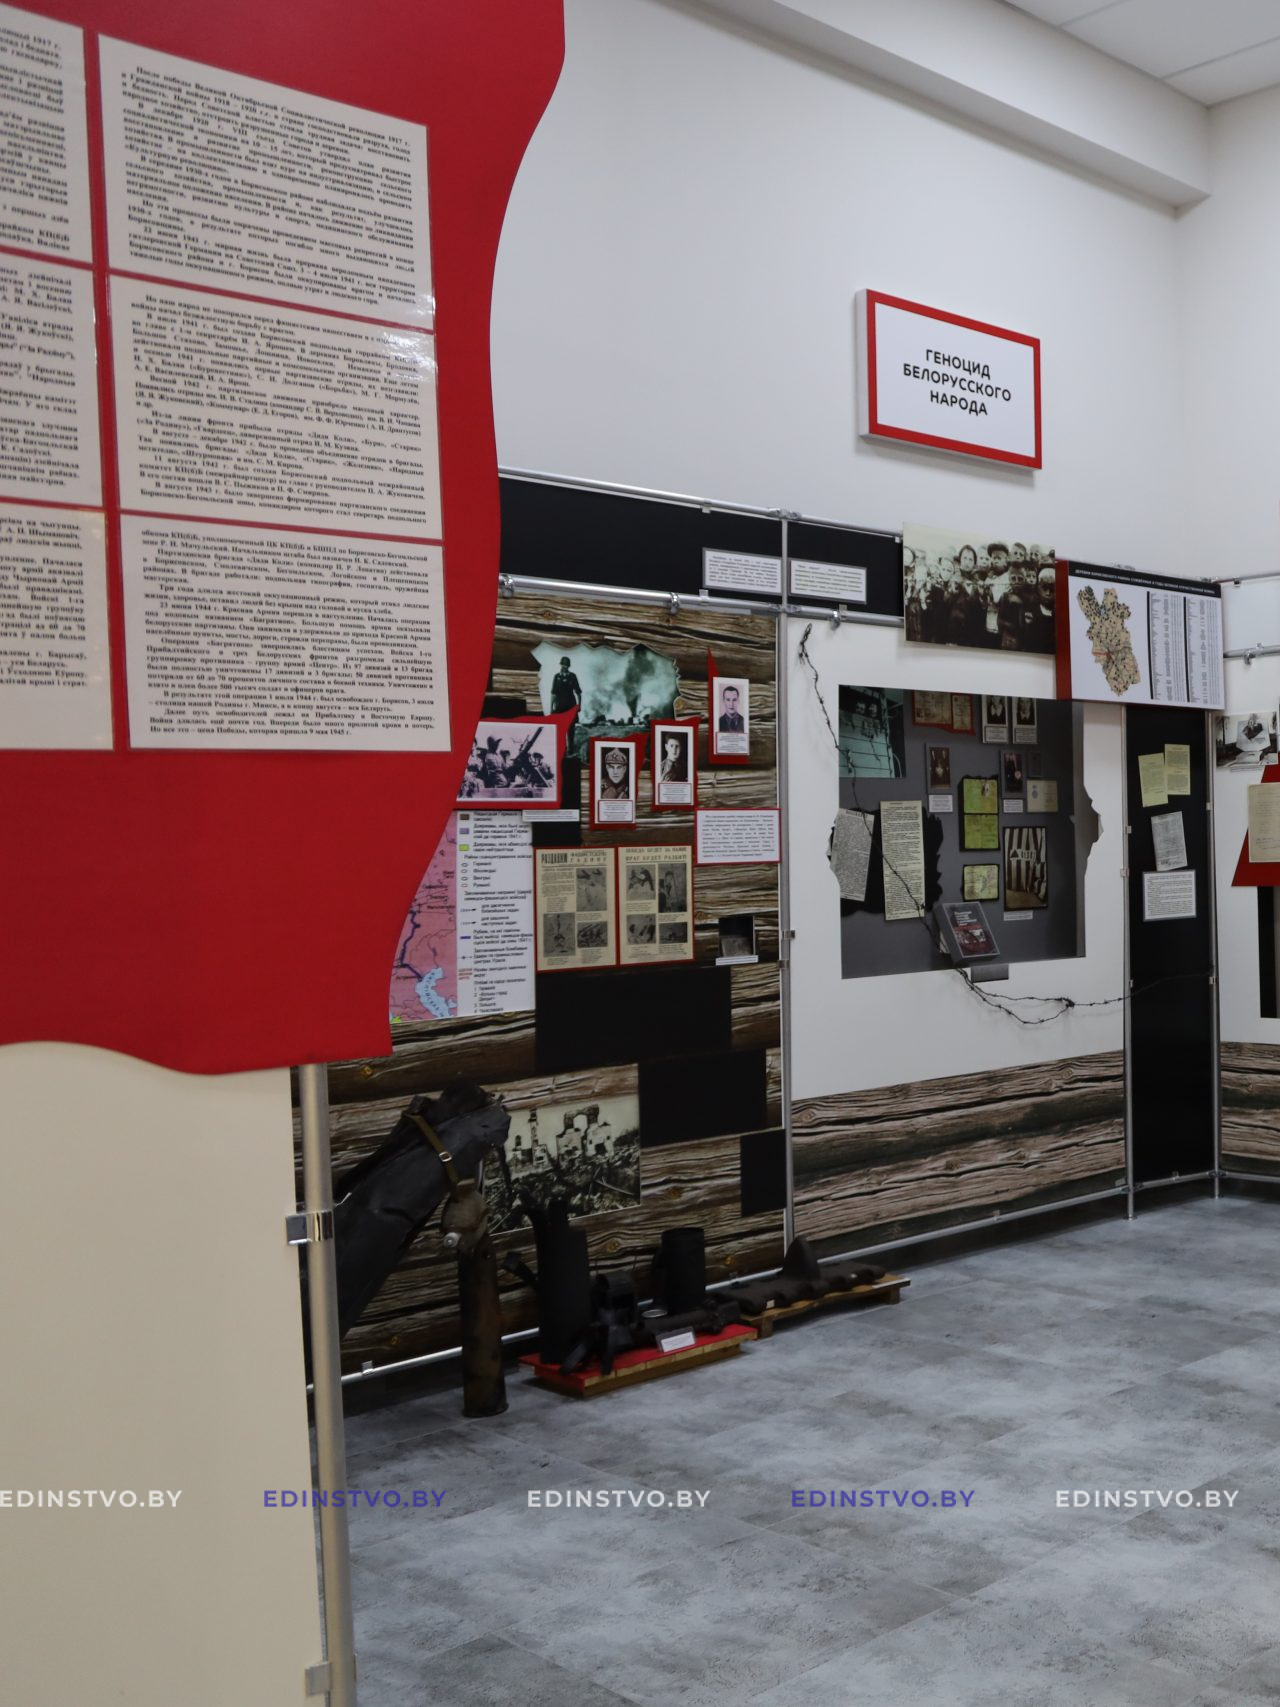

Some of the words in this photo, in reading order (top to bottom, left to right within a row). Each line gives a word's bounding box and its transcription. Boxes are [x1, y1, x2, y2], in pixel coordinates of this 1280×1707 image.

[926, 349, 990, 380] ГЕНОЦИД
[903, 363, 1011, 402] БЕЛОРУССКОГО
[930, 390, 988, 416] НАРОДА
